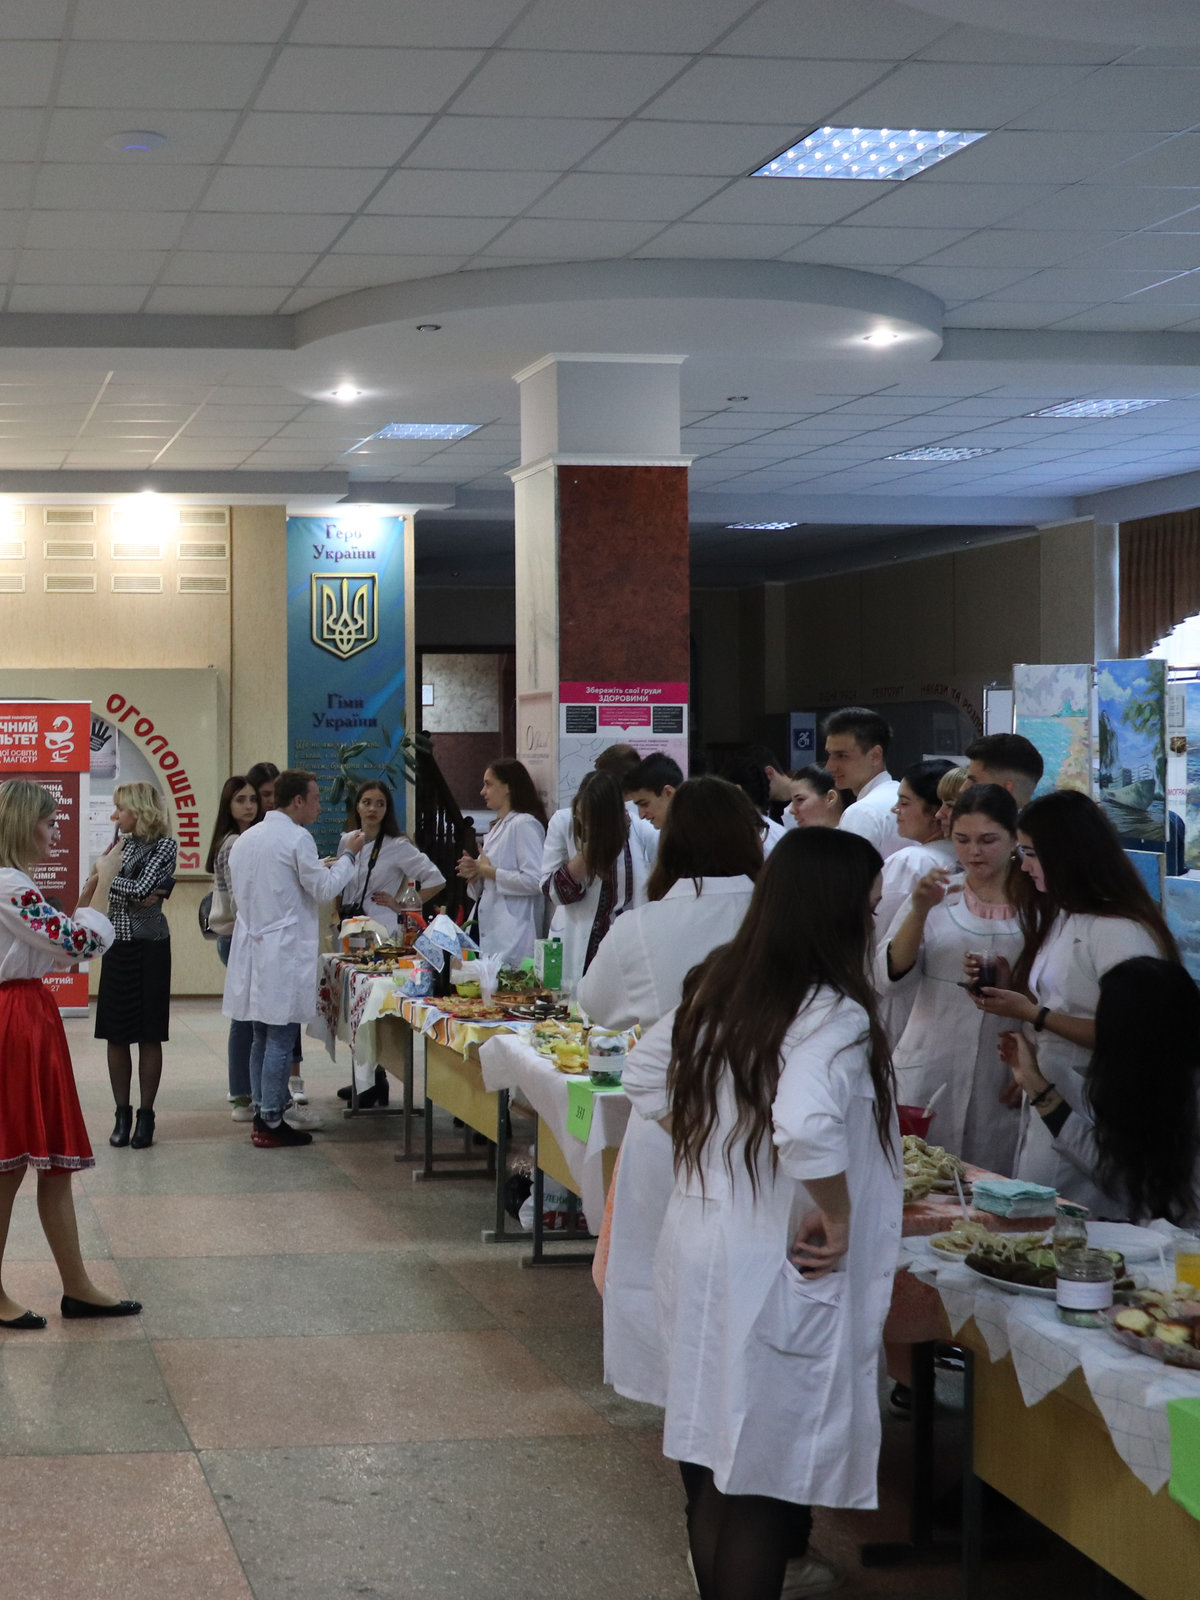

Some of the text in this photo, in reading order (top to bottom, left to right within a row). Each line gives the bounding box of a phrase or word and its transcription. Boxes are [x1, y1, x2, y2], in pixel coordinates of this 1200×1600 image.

[312, 544, 377, 563] України
[327, 693, 364, 709] Гімн
[312, 712, 378, 731] України
[106, 693, 200, 869] ОГОЛОШЕННЯ
[576, 1105, 585, 1120] 331
